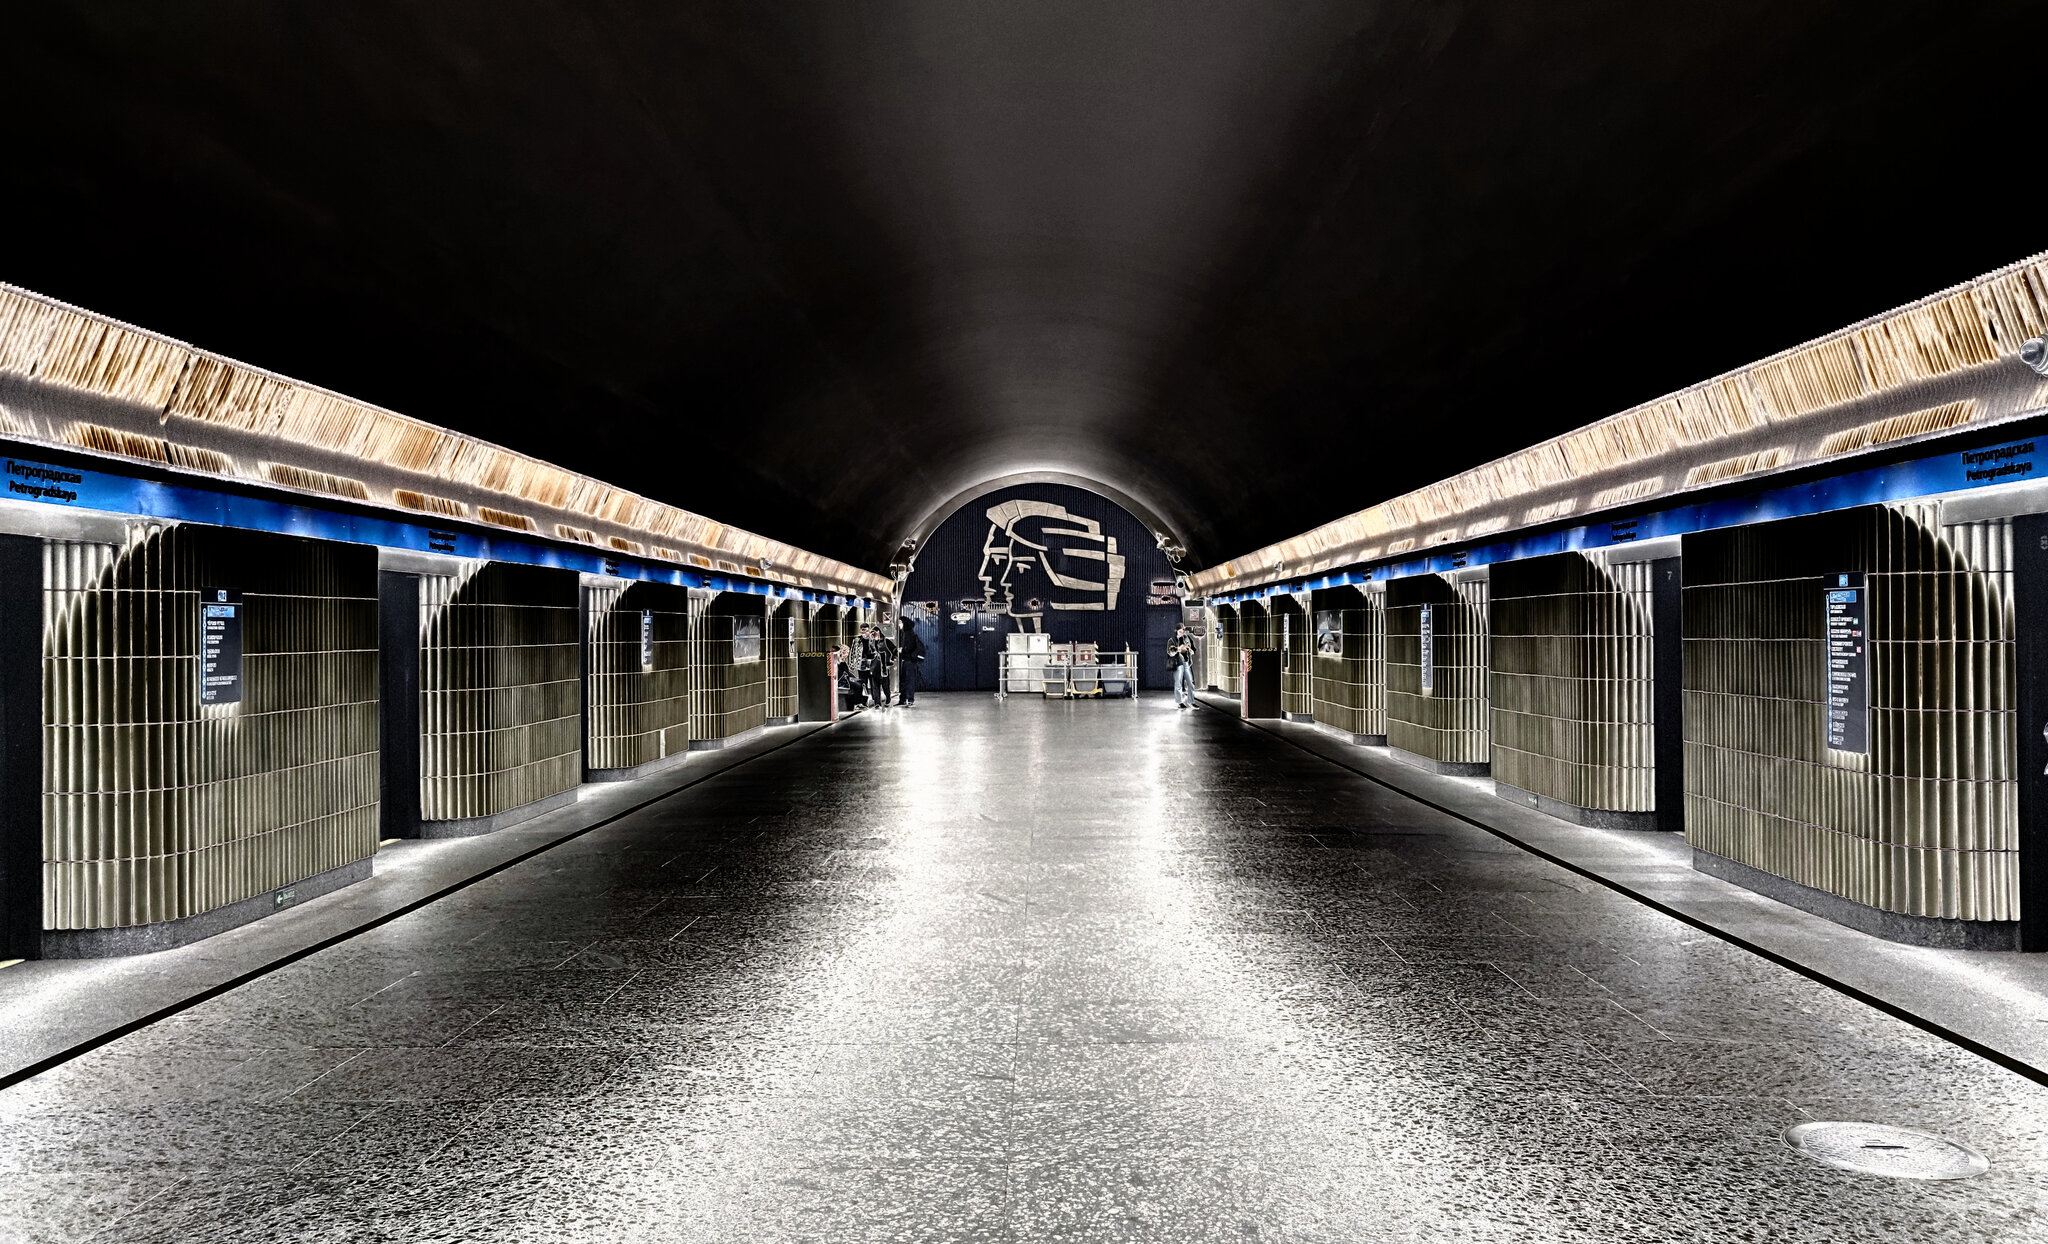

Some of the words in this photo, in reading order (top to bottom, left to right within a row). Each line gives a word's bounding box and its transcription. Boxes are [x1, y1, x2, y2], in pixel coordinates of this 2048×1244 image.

[1962, 442, 2035, 465] Петроградская
[7, 461, 82, 484] Петроградская
[1966, 462, 2032, 482] Petrogradskaya
[9, 480, 77, 502] Petrogradskaya
